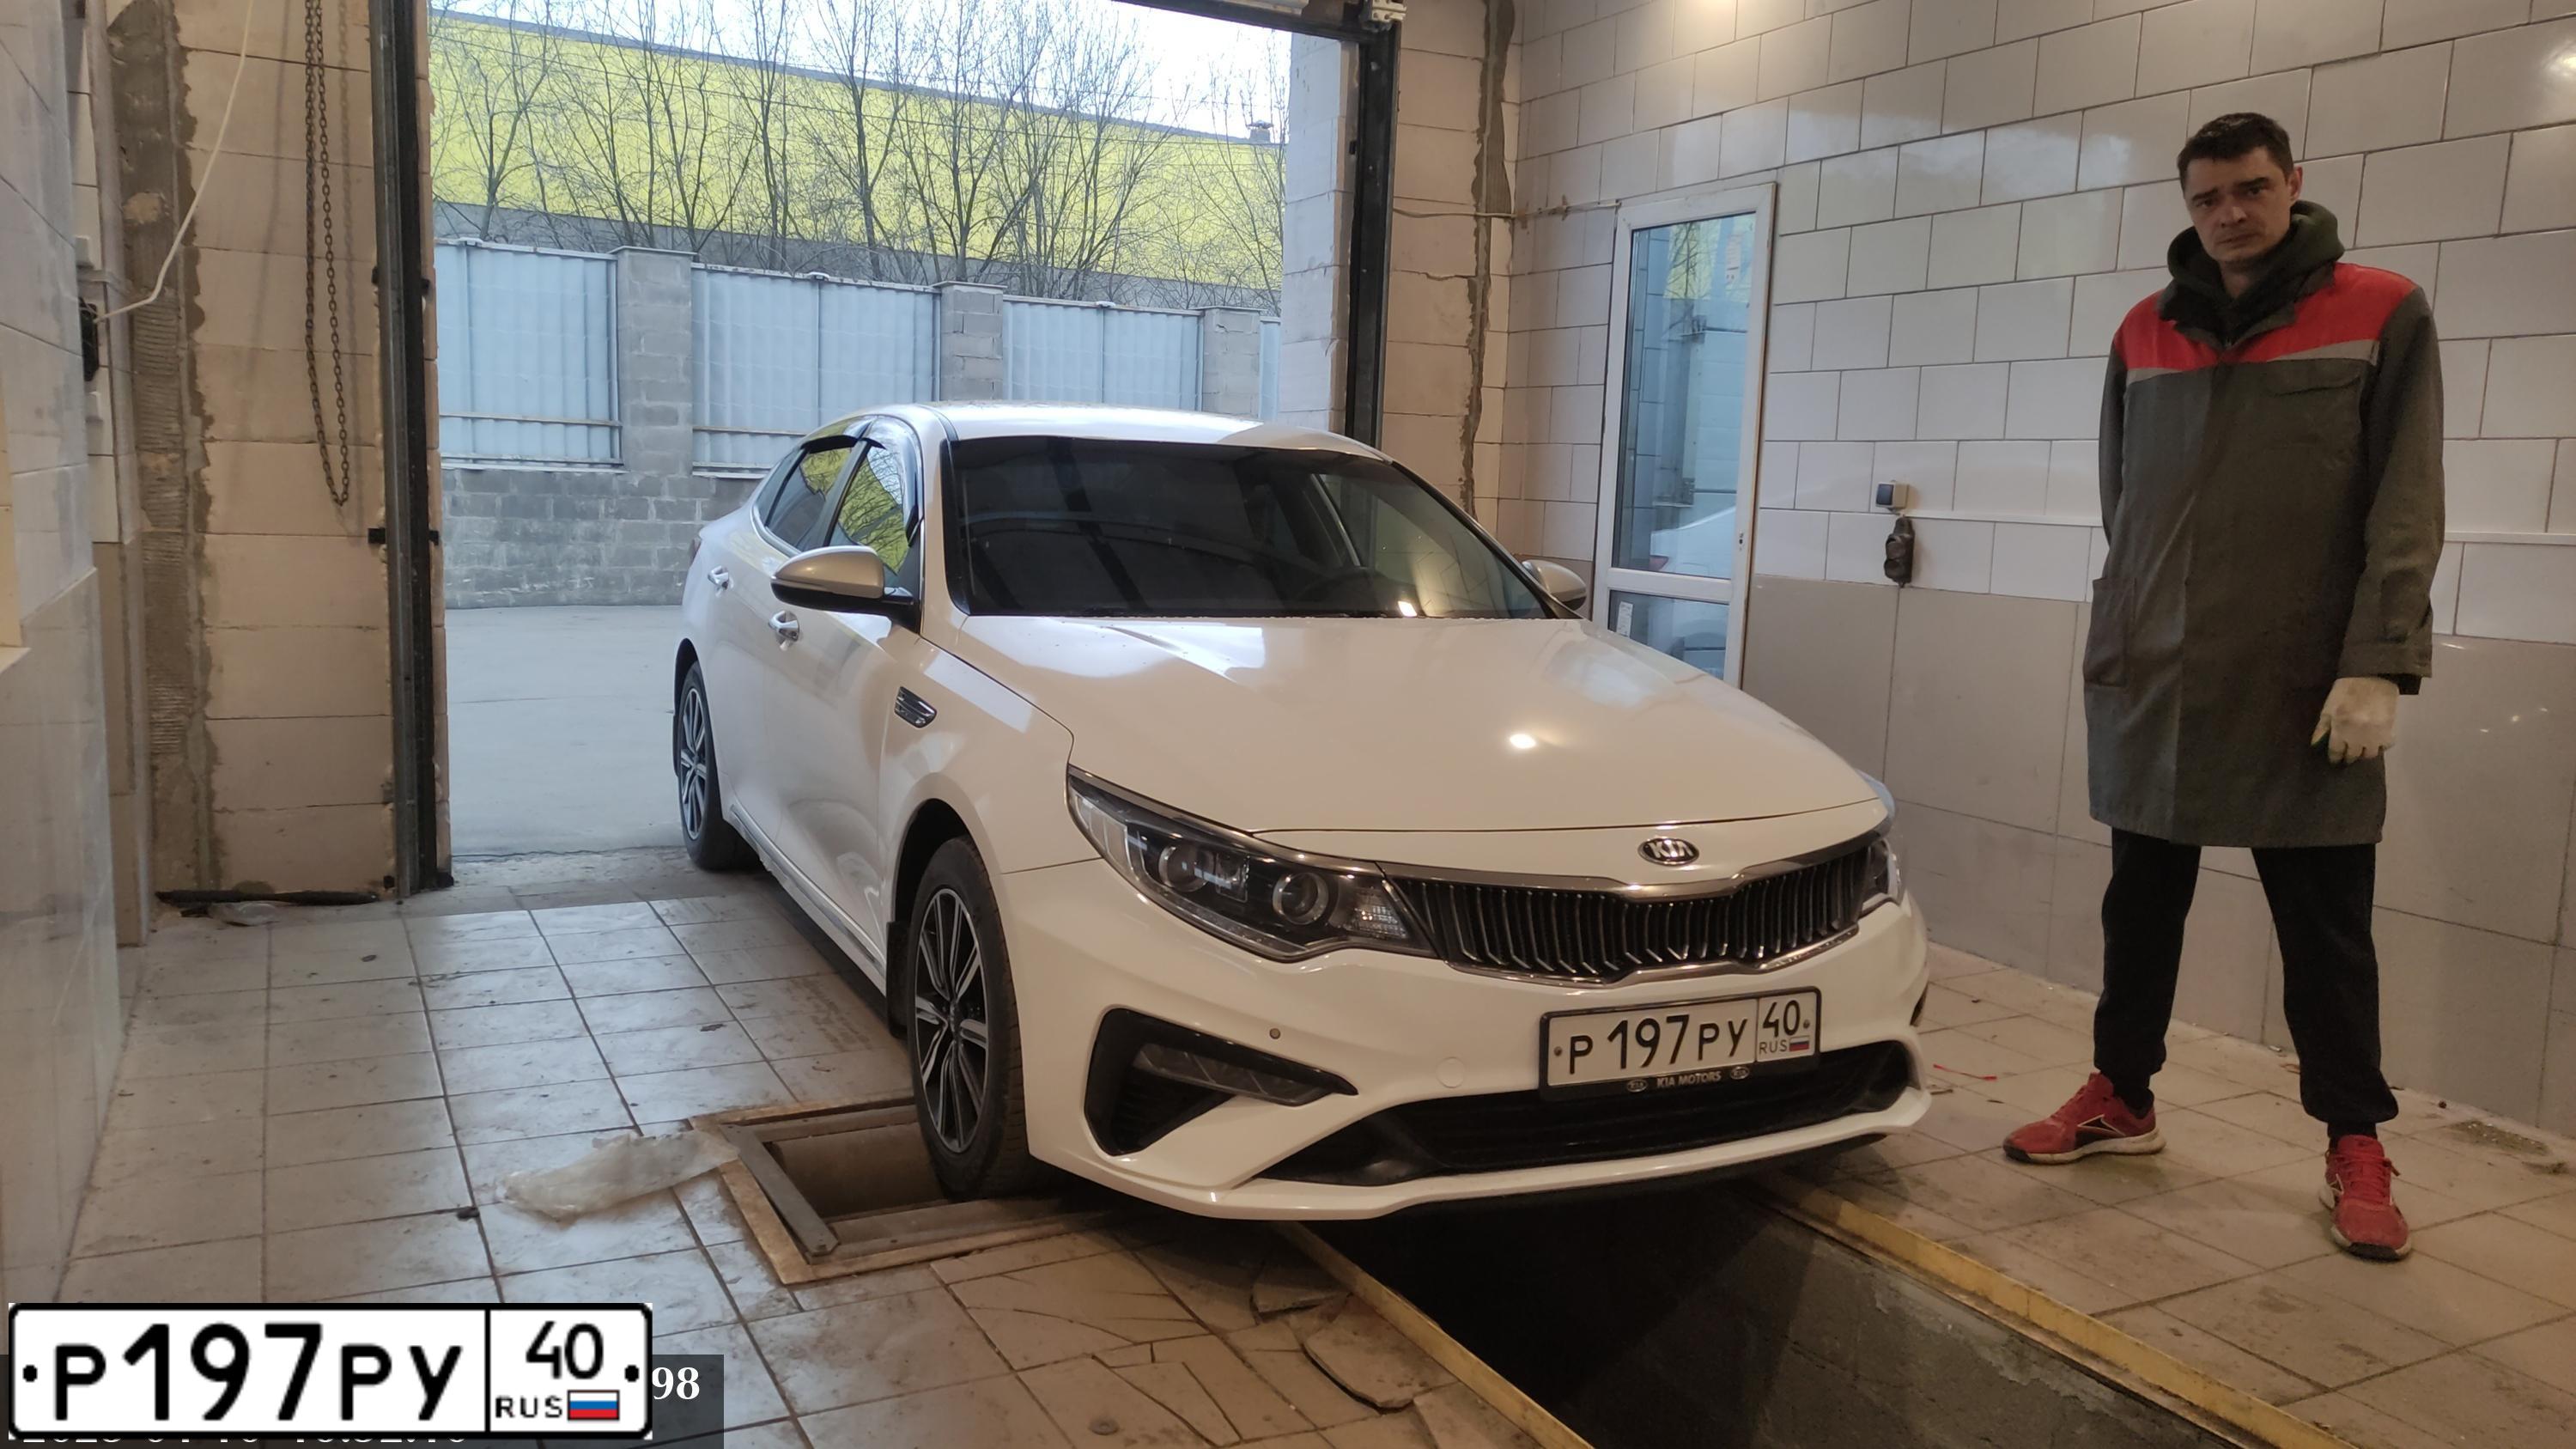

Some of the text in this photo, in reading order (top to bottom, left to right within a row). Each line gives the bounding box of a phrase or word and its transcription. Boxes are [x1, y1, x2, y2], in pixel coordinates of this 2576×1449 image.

[1648, 841, 1694, 858] KIA
[1763, 1000, 1801, 1038] 40
[1759, 1041, 1788, 1056] RUS
[1656, 1077, 1674, 1088] KIA
[1678, 1071, 1722, 1086] MOTORS
